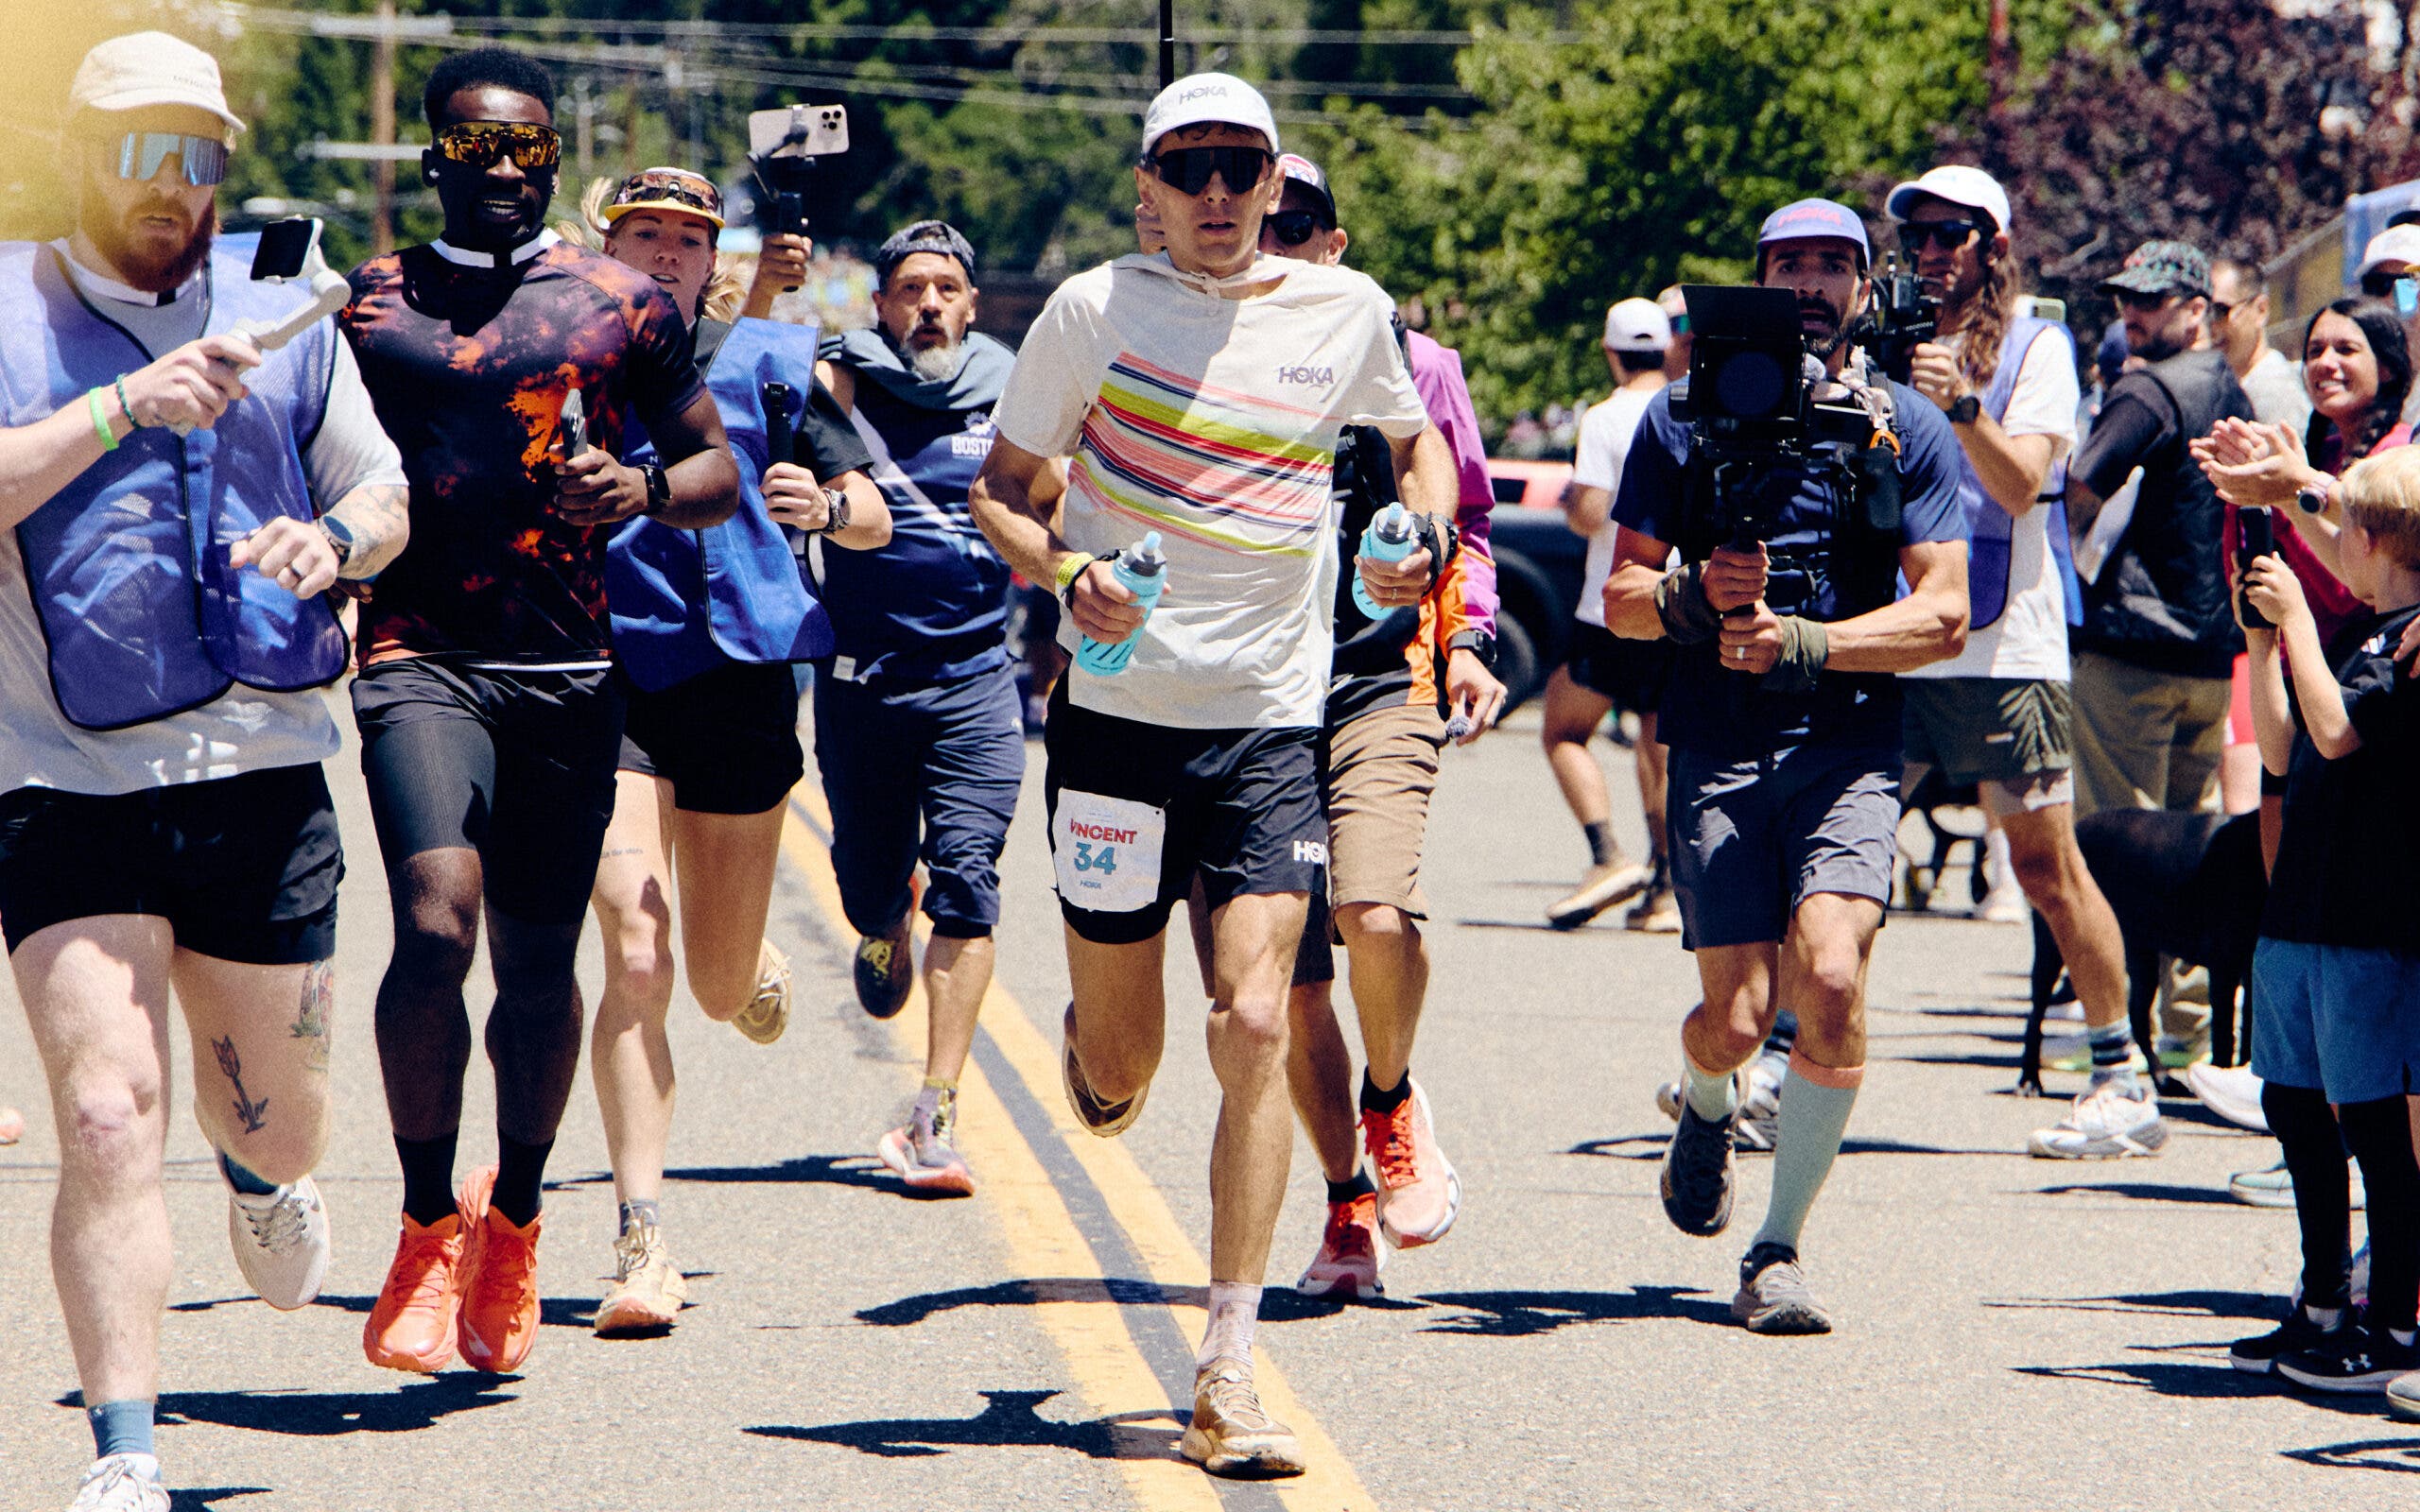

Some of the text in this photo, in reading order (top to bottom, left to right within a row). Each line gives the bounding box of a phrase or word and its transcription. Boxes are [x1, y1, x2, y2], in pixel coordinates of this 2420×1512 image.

[1179, 85, 1228, 106] HOKA
[1277, 366, 1335, 385] HOKA
[1070, 817, 1137, 845] VNCENT
[1073, 841, 1117, 876] 34
